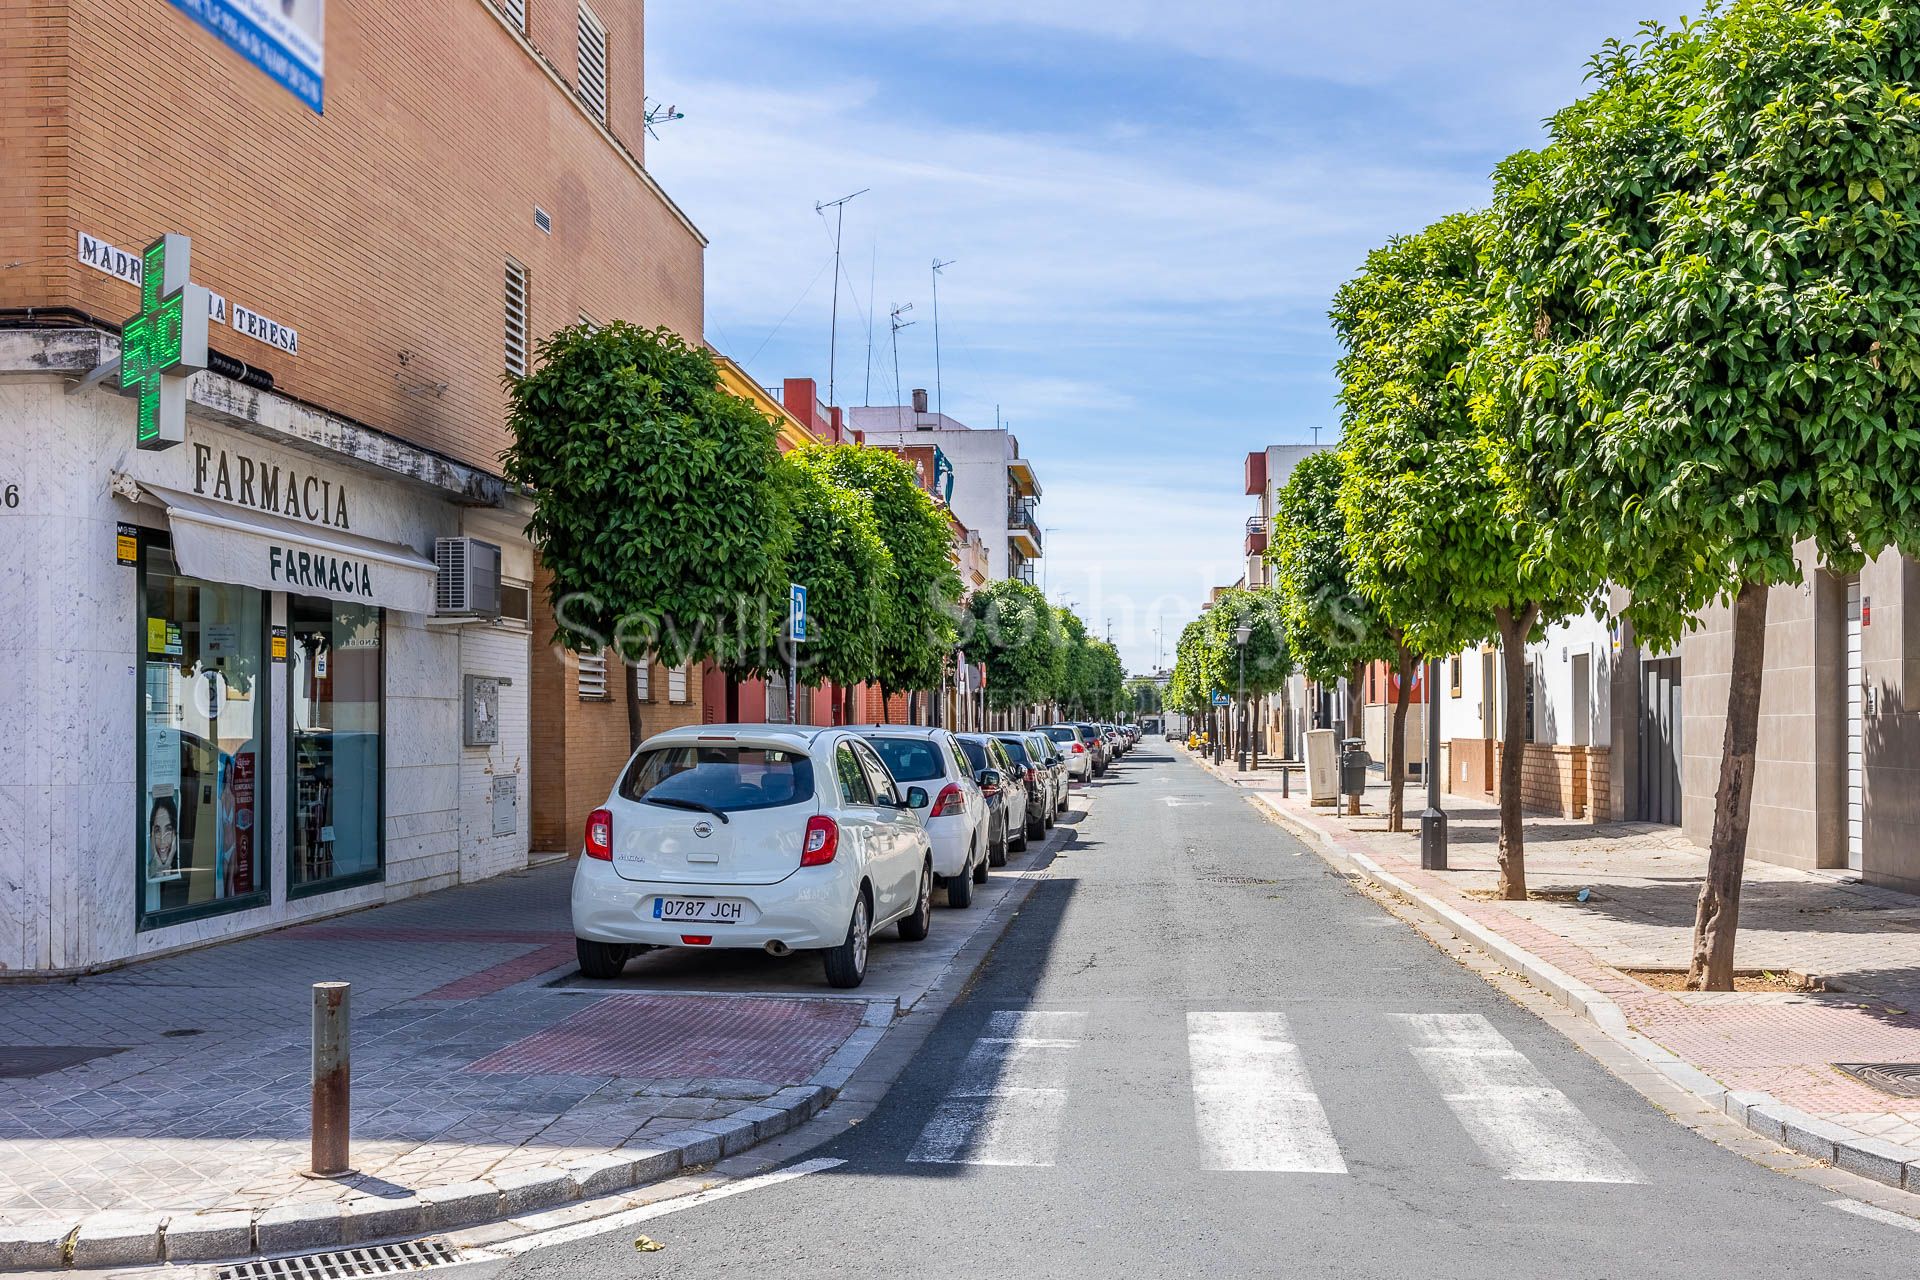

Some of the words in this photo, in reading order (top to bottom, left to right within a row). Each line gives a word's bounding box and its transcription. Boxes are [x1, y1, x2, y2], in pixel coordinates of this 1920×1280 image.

[82, 236, 141, 284] MADR
[235, 308, 298, 352] TERESA
[0, 484, 20, 509] 6
[193, 442, 350, 529] FARMACIA
[269, 545, 373, 597] FARMACIA
[664, 900, 706, 917] 0787
[711, 903, 742, 919] JCH
